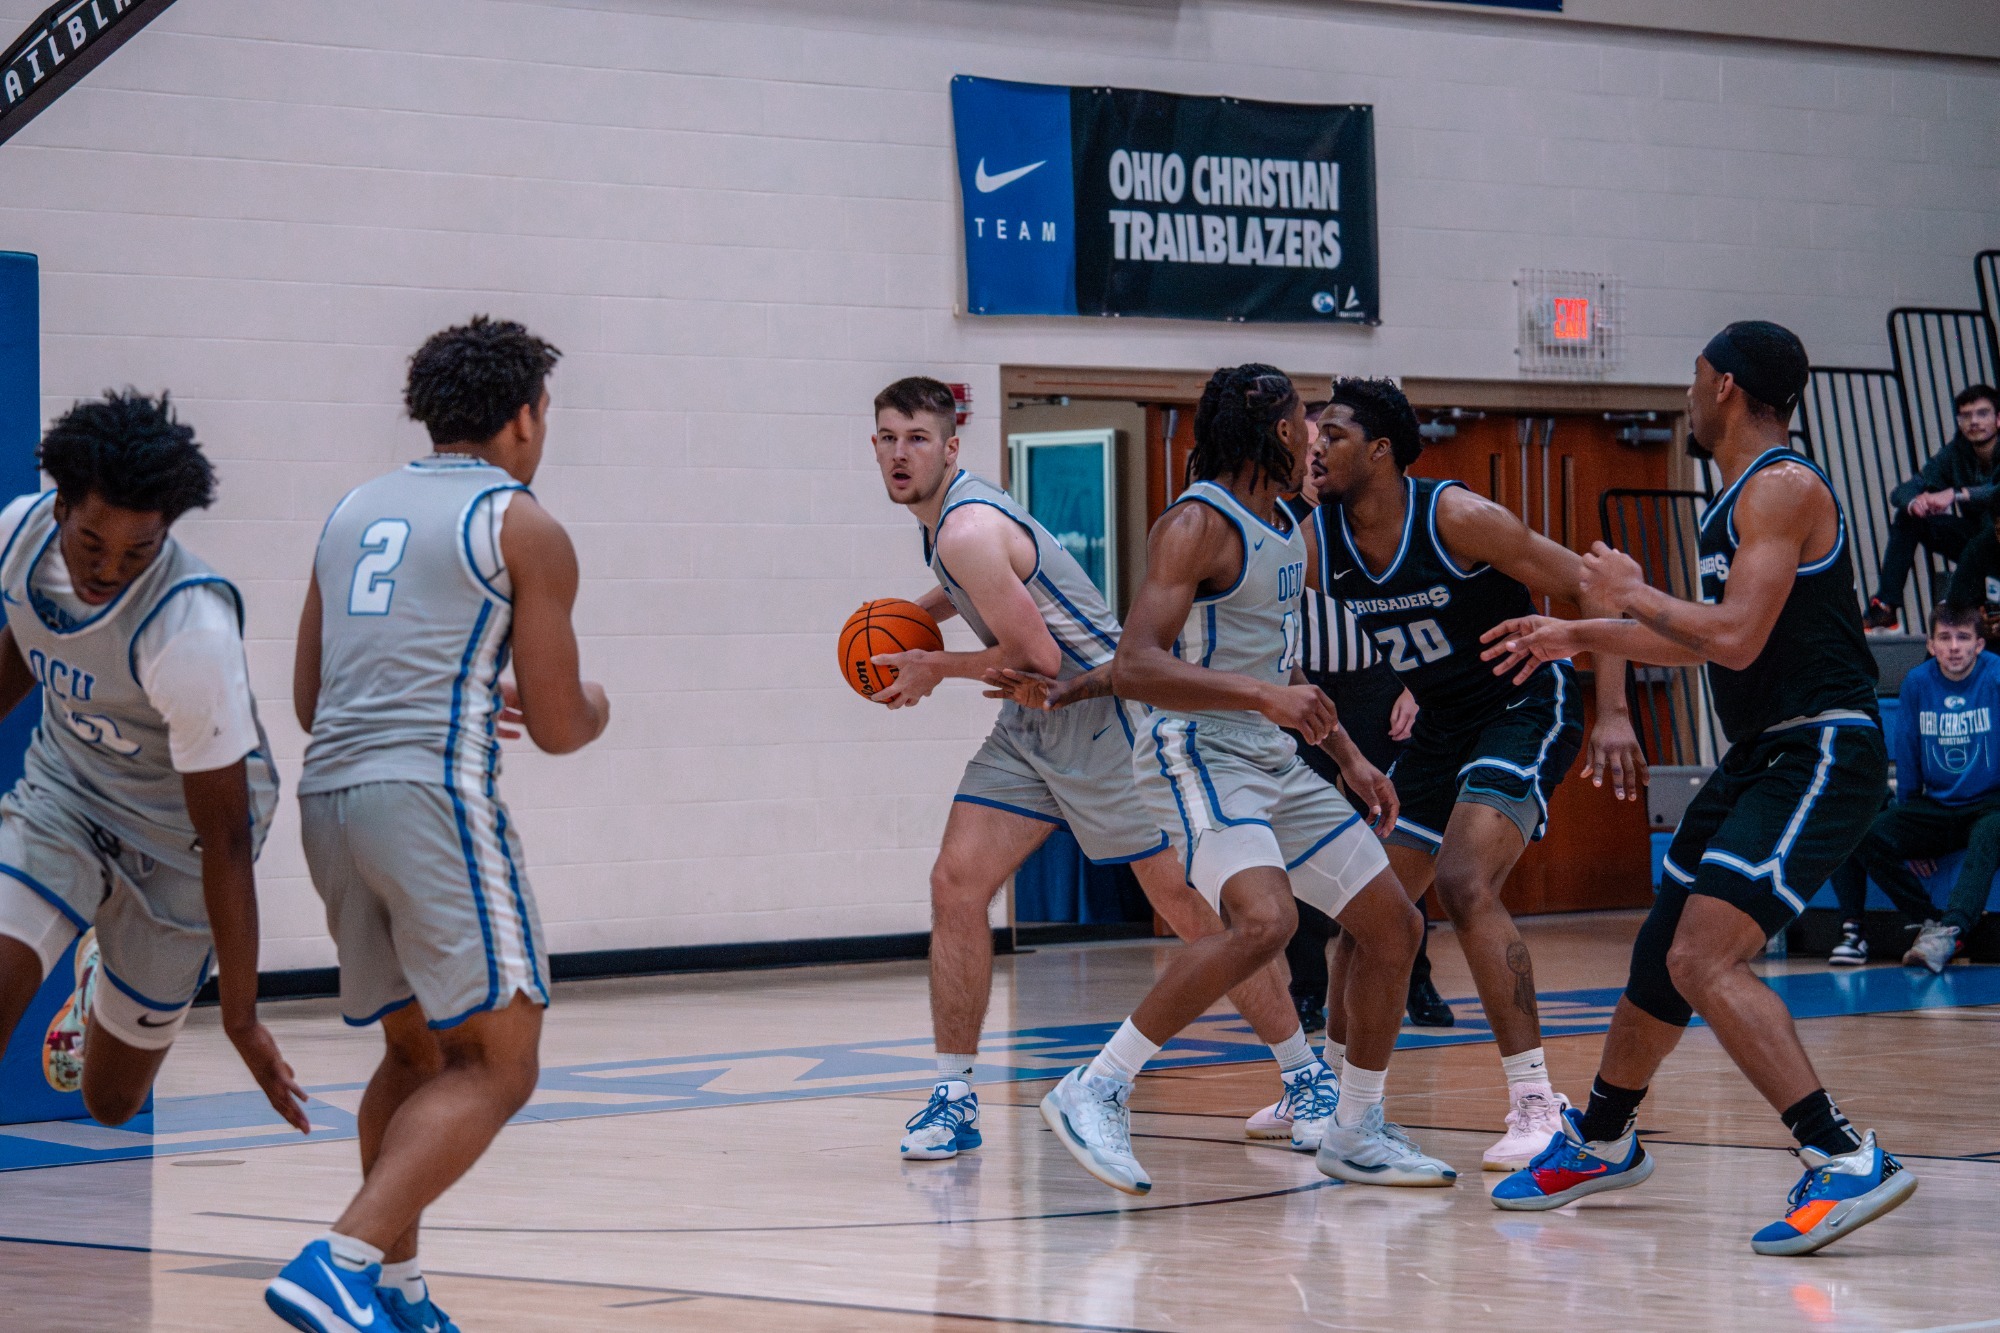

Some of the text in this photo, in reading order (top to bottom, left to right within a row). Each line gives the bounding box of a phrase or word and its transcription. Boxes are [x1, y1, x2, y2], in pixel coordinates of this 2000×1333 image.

[1109, 149, 1340, 211] OHIO CHRISTIAN
[974, 217, 1057, 242] TEAM
[1109, 210, 1342, 269] TRAILBLAZERS
[1554, 298, 1589, 339] EXIT
[348, 518, 411, 616] 2
[1278, 562, 1303, 603] OCU
[1374, 618, 1454, 673] 20
[29, 649, 95, 701] OCU
[1939, 707, 1991, 736] CHRISTIAN
